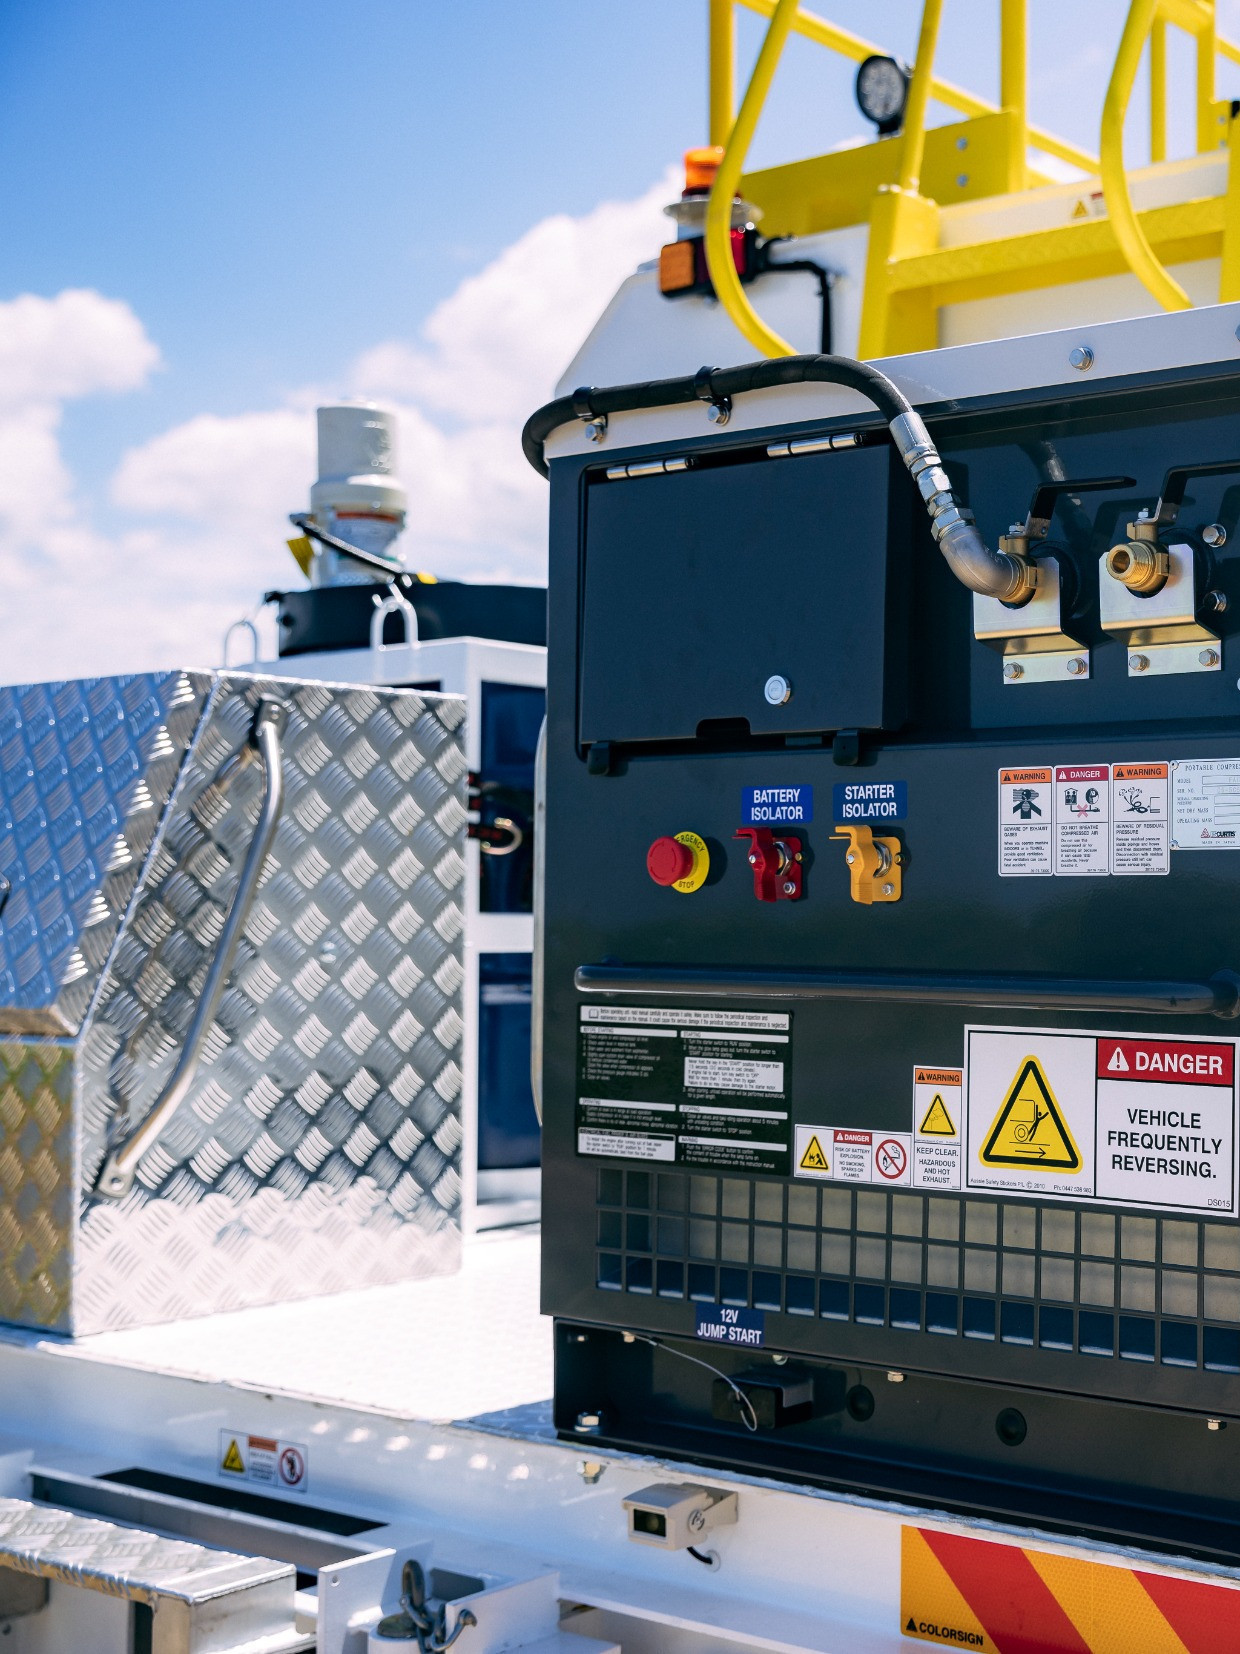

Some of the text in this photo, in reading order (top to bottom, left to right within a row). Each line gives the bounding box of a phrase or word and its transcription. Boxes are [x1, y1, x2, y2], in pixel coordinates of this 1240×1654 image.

[1127, 768, 1161, 776] WARNING
[754, 789, 800, 803] BATTERY
[845, 784, 894, 800] STARTER
[751, 807, 803, 821] ISOLATOR
[843, 802, 897, 817] ISOLATOR
[1135, 1052, 1223, 1075] DANGER
[926, 1073, 960, 1082] WARNING
[1127, 1109, 1201, 1129] VEHICLE
[844, 1134, 869, 1142] DANGER
[1108, 1130, 1222, 1155] FREQUENTLY
[916, 1147, 959, 1157] KEEP CLEAR.
[919, 1159, 955, 1167] HAZARDOUS
[1112, 1155, 1217, 1178] REVERSING.
[923, 1175, 951, 1184] EXHAUST.
[1207, 1198, 1231, 1208] DS015
[720, 1309, 739, 1324] 12V
[697, 1322, 762, 1344] JUMP START
[919, 1622, 984, 1646] COLORSIGN
